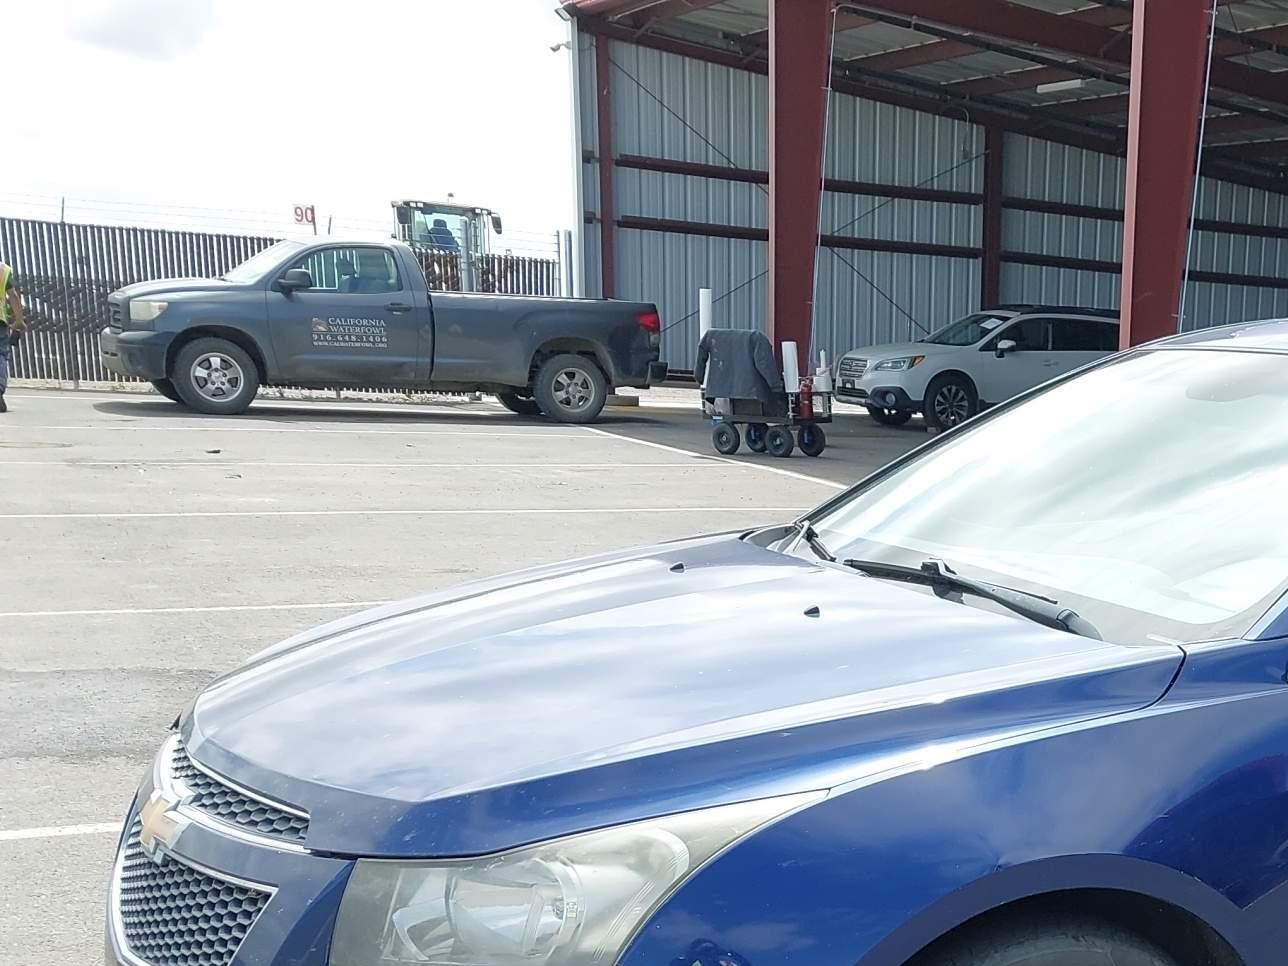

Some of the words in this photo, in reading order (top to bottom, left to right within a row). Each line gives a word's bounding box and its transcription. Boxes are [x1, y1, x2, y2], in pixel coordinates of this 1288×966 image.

[294, 206, 314, 223] 90
[328, 317, 386, 327] CALIFORNIA
[328, 325, 385, 334] WATERFOWL
[312, 333, 388, 342] 916.648.1406
